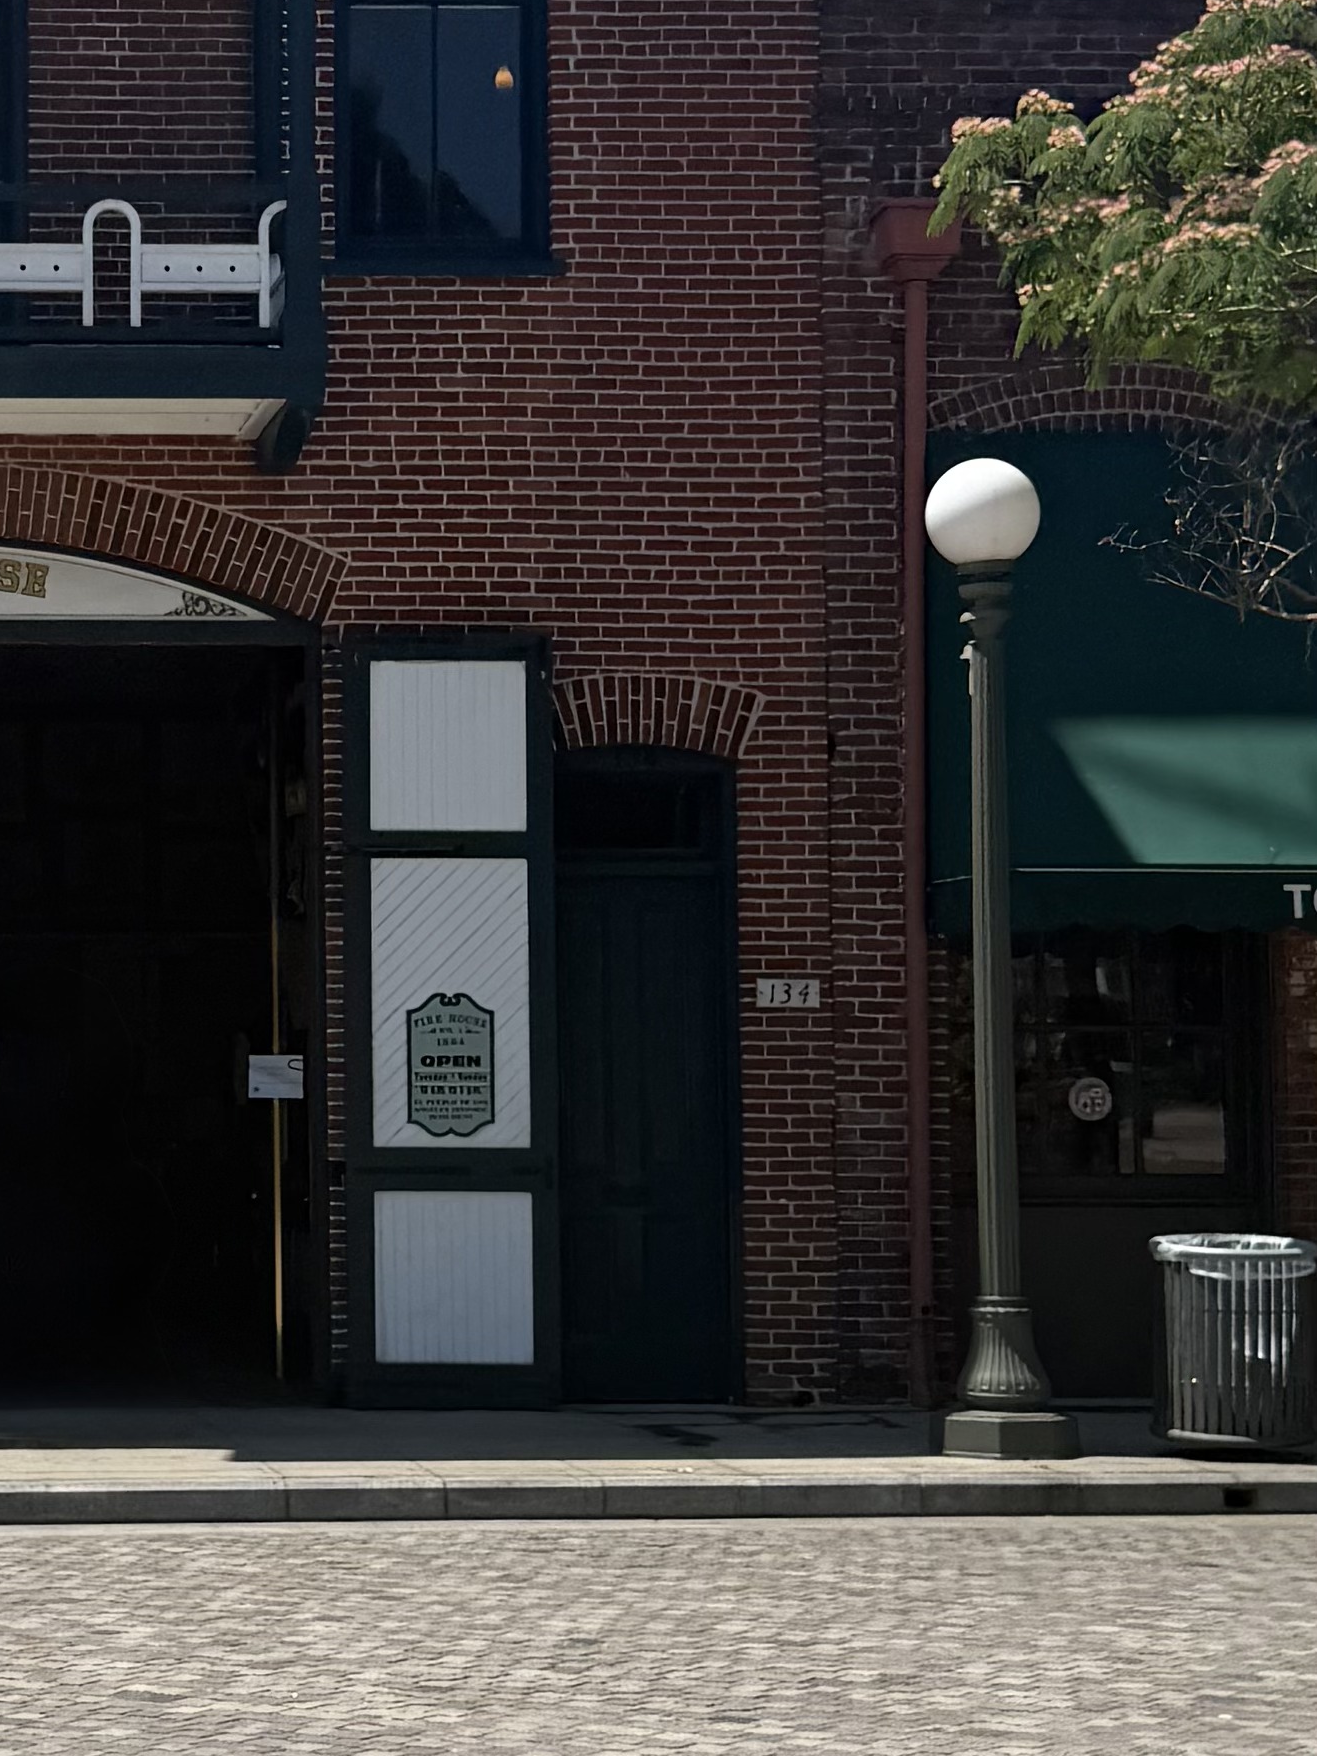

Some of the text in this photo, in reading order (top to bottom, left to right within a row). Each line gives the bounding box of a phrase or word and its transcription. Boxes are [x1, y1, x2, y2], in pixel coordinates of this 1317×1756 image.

[1283, 883, 1317, 919] T
[769, 982, 810, 1005] 134
[414, 1013, 487, 1028] FIRE HOUSE
[420, 1055, 482, 1067] OPEN
